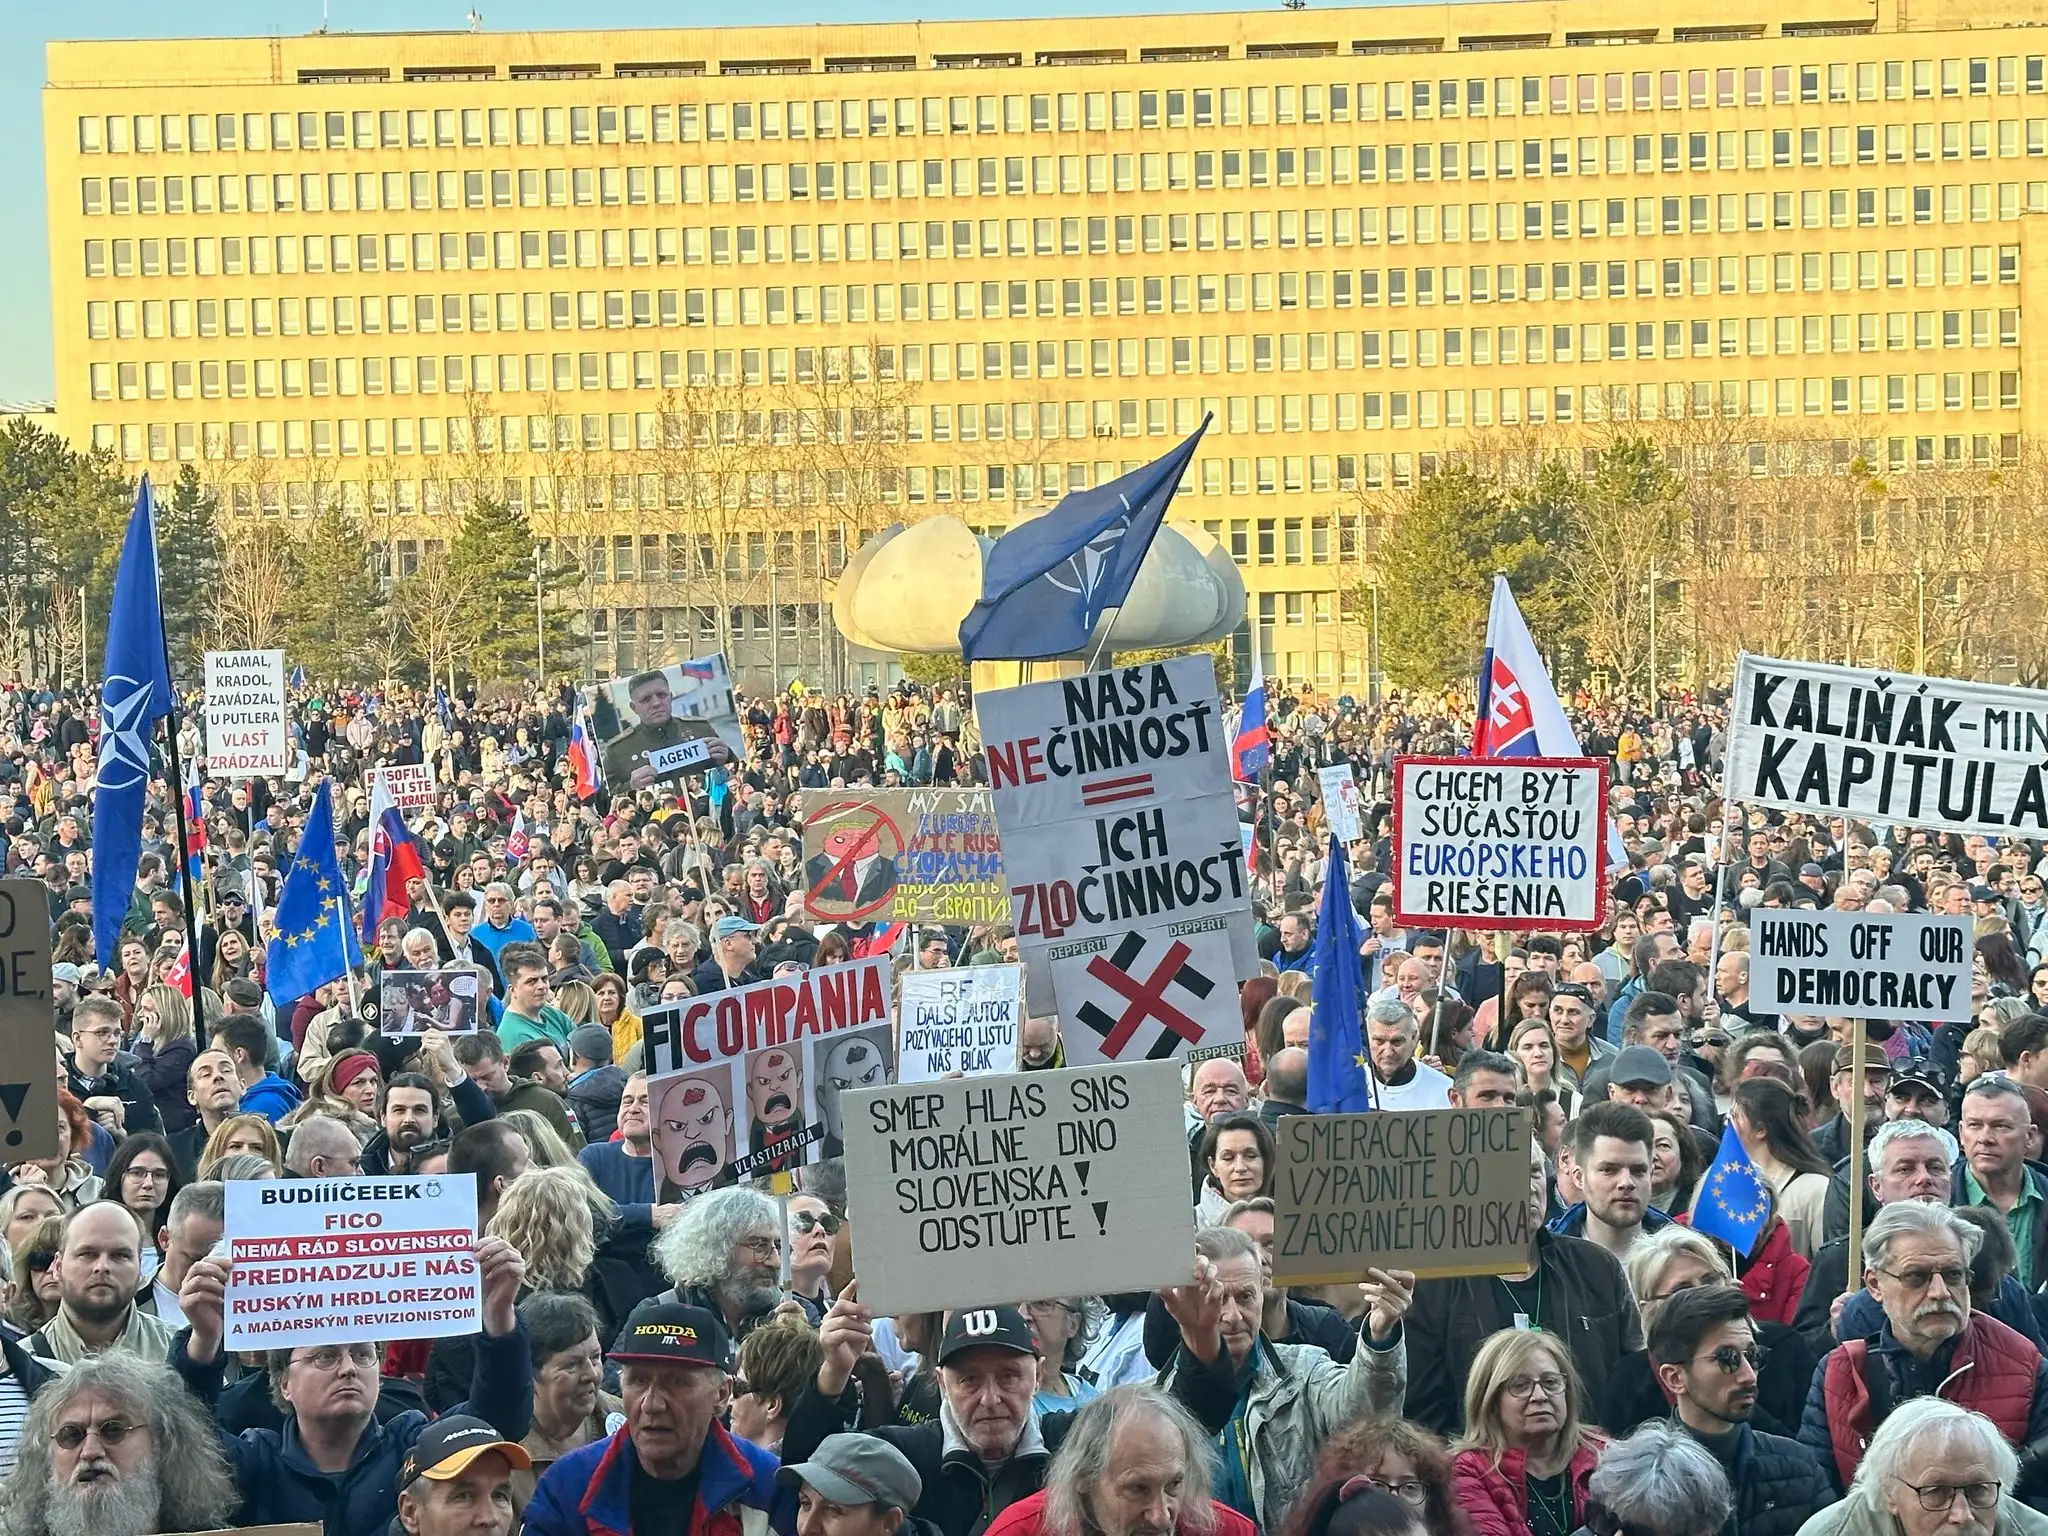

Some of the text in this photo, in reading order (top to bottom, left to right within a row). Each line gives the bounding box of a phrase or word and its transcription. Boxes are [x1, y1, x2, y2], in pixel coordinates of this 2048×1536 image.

[216, 655, 271, 668] KLAMAL,
[217, 675, 272, 687] KRADOL,
[1062, 663, 1178, 726] NAŠA
[209, 692, 280, 706] ZAVÁDZAL,
[211, 712, 279, 725] U PUTLERA
[222, 730, 269, 747] VLASŤ
[986, 700, 1211, 790] NEČINNOSŤ
[209, 753, 283, 769] ZRÁDZAL!
[659, 745, 699, 767] AGENT
[409, 780, 431, 792] STE
[1416, 769, 1580, 805] CHCEM BYŤ
[907, 791, 944, 814] MY
[920, 814, 992, 835] EUROPA
[1421, 801, 1581, 841] SÚČASŤOU
[907, 833, 1001, 855] NIE RUS
[1096, 808, 1169, 866] ICH
[1409, 839, 1587, 880] EURÓPSKEHO
[1011, 841, 1244, 939] ZLOČINNOSŤ
[1427, 878, 1566, 917] RIEŠENIA
[892, 897, 917, 918] ДО
[1169, 916, 1226, 936] DEPPERT!
[1050, 939, 1107, 960] DEPPERT!
[1760, 921, 1963, 963] HANDS OFF OUR
[1777, 967, 1957, 1010] DEMOCRACY
[642, 965, 886, 1076] FICOMPÁNIA
[928, 1048, 951, 1073] NÁŠ
[1189, 1041, 1247, 1061] DEPPERT!
[869, 1074, 1129, 1134] SMER HLAS SNS
[735, 1129, 814, 1174] VLASTIZRADA
[890, 1118, 1117, 1174] MORÁLNE DNO
[1290, 1114, 1437, 1164] SMERÁCKE
[1449, 1157, 1480, 1197] DO
[261, 1183, 422, 1205] BUDÍÍÍČEEEK
[324, 1212, 383, 1230] FICO
[919, 1203, 1075, 1253] ODSTÚPTE
[1280, 1200, 1529, 1256] ZASRANÉHO RUSKA
[232, 1240, 295, 1259] NEMÁ
[298, 1237, 339, 1256] RÁD
[232, 1255, 475, 1287] PREDHADZUJE NÁS
[232, 1286, 475, 1315] RUSKÝM HRDLOREZOM
[232, 1308, 475, 1335] A MAĎARSKÝM REVIZIONISTOM
[634, 1325, 698, 1338] HONDA
